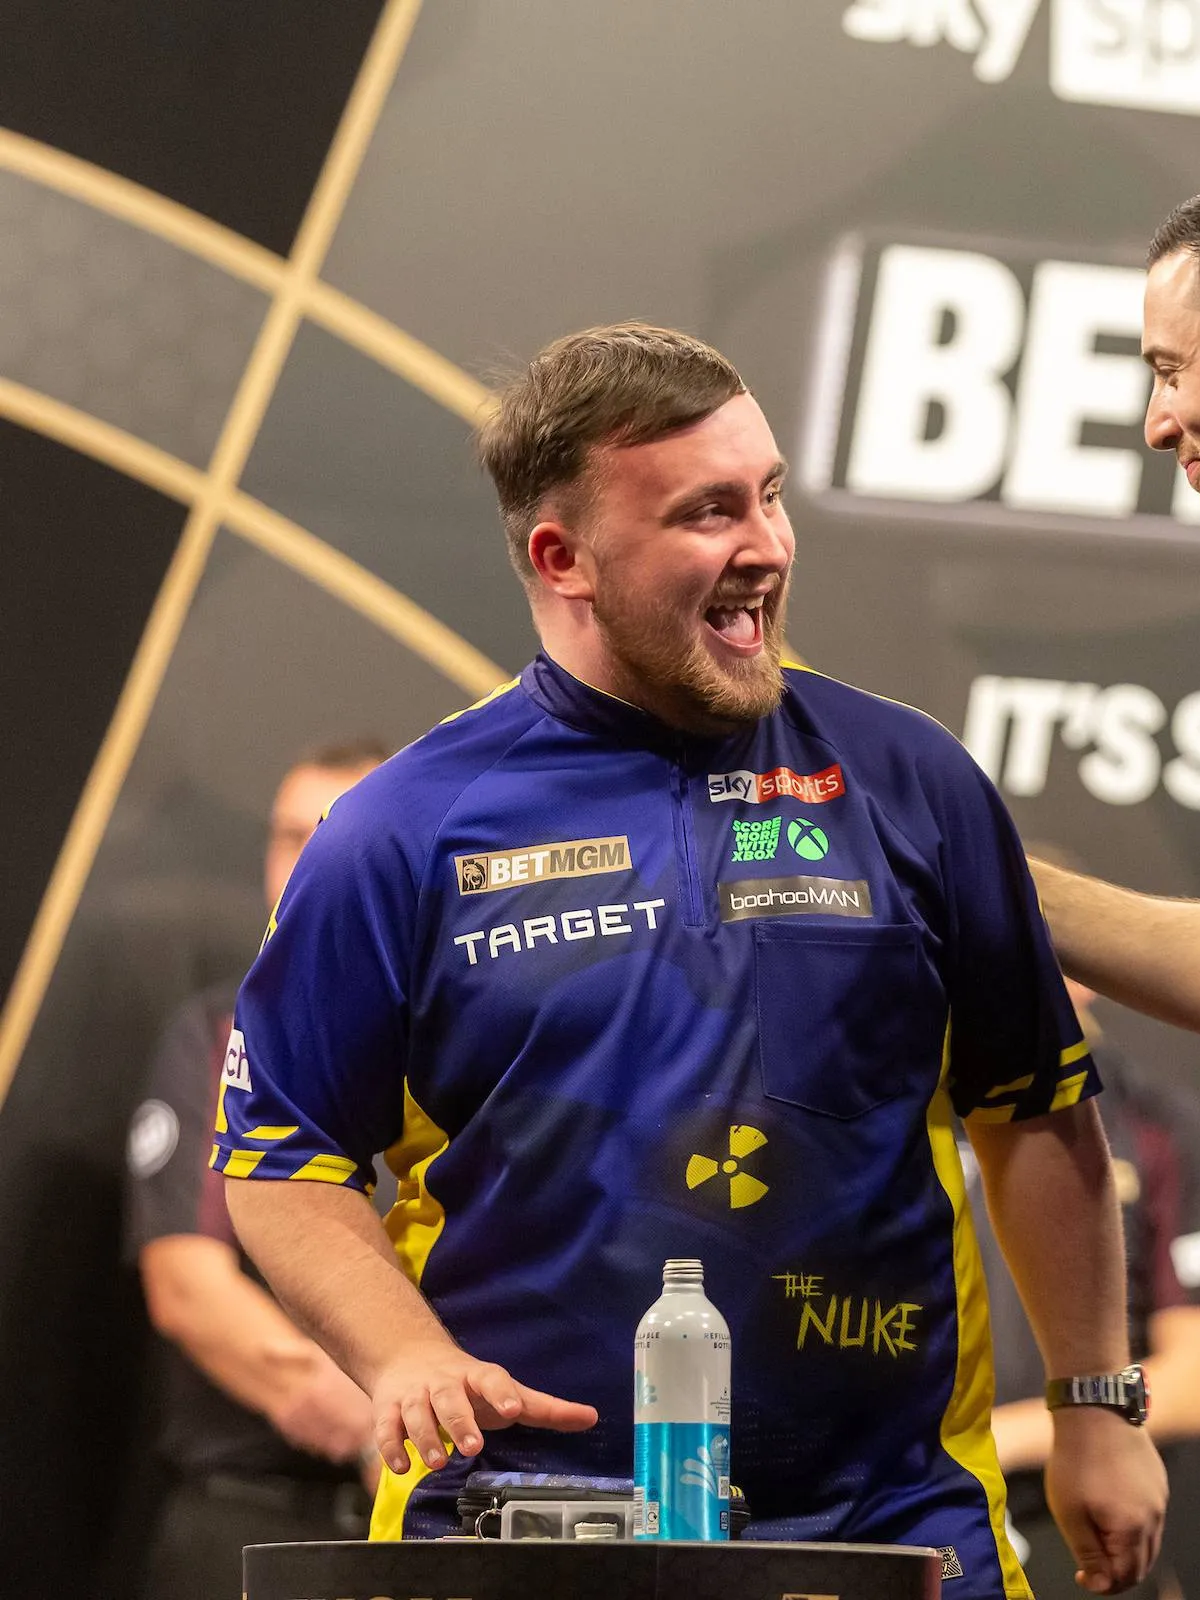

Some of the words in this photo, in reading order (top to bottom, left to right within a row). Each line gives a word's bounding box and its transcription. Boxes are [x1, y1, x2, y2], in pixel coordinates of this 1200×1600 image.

[962, 675, 1168, 806] IT'S
[708, 774, 752, 799] sky
[761, 773, 839, 797] sports
[732, 815, 782, 832] SCORE
[735, 828, 780, 842] MORE
[731, 848, 776, 862] XBOX
[737, 838, 778, 851] WITH
[490, 842, 625, 885] BETMGM
[730, 886, 860, 910] boohooMAN
[453, 898, 666, 965] TARGET
[771, 1271, 824, 1298] THE
[797, 1294, 924, 1358] NUKE
